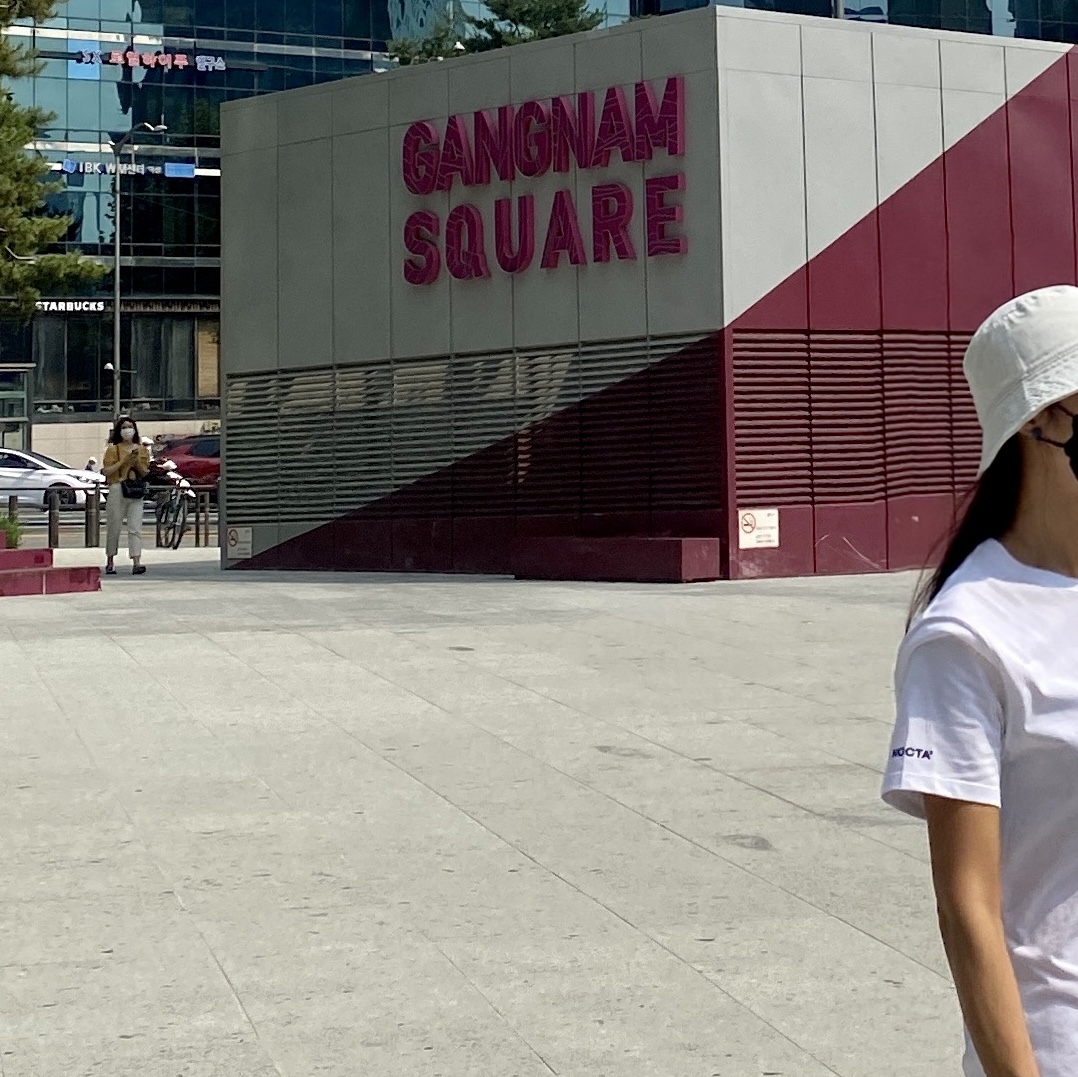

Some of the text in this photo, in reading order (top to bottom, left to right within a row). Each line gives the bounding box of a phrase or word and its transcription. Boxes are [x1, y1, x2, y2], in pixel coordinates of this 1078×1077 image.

[79, 162, 102, 173] IBK
[402, 75, 685, 195] GANGNAM
[403, 172, 688, 285] SQUARE
